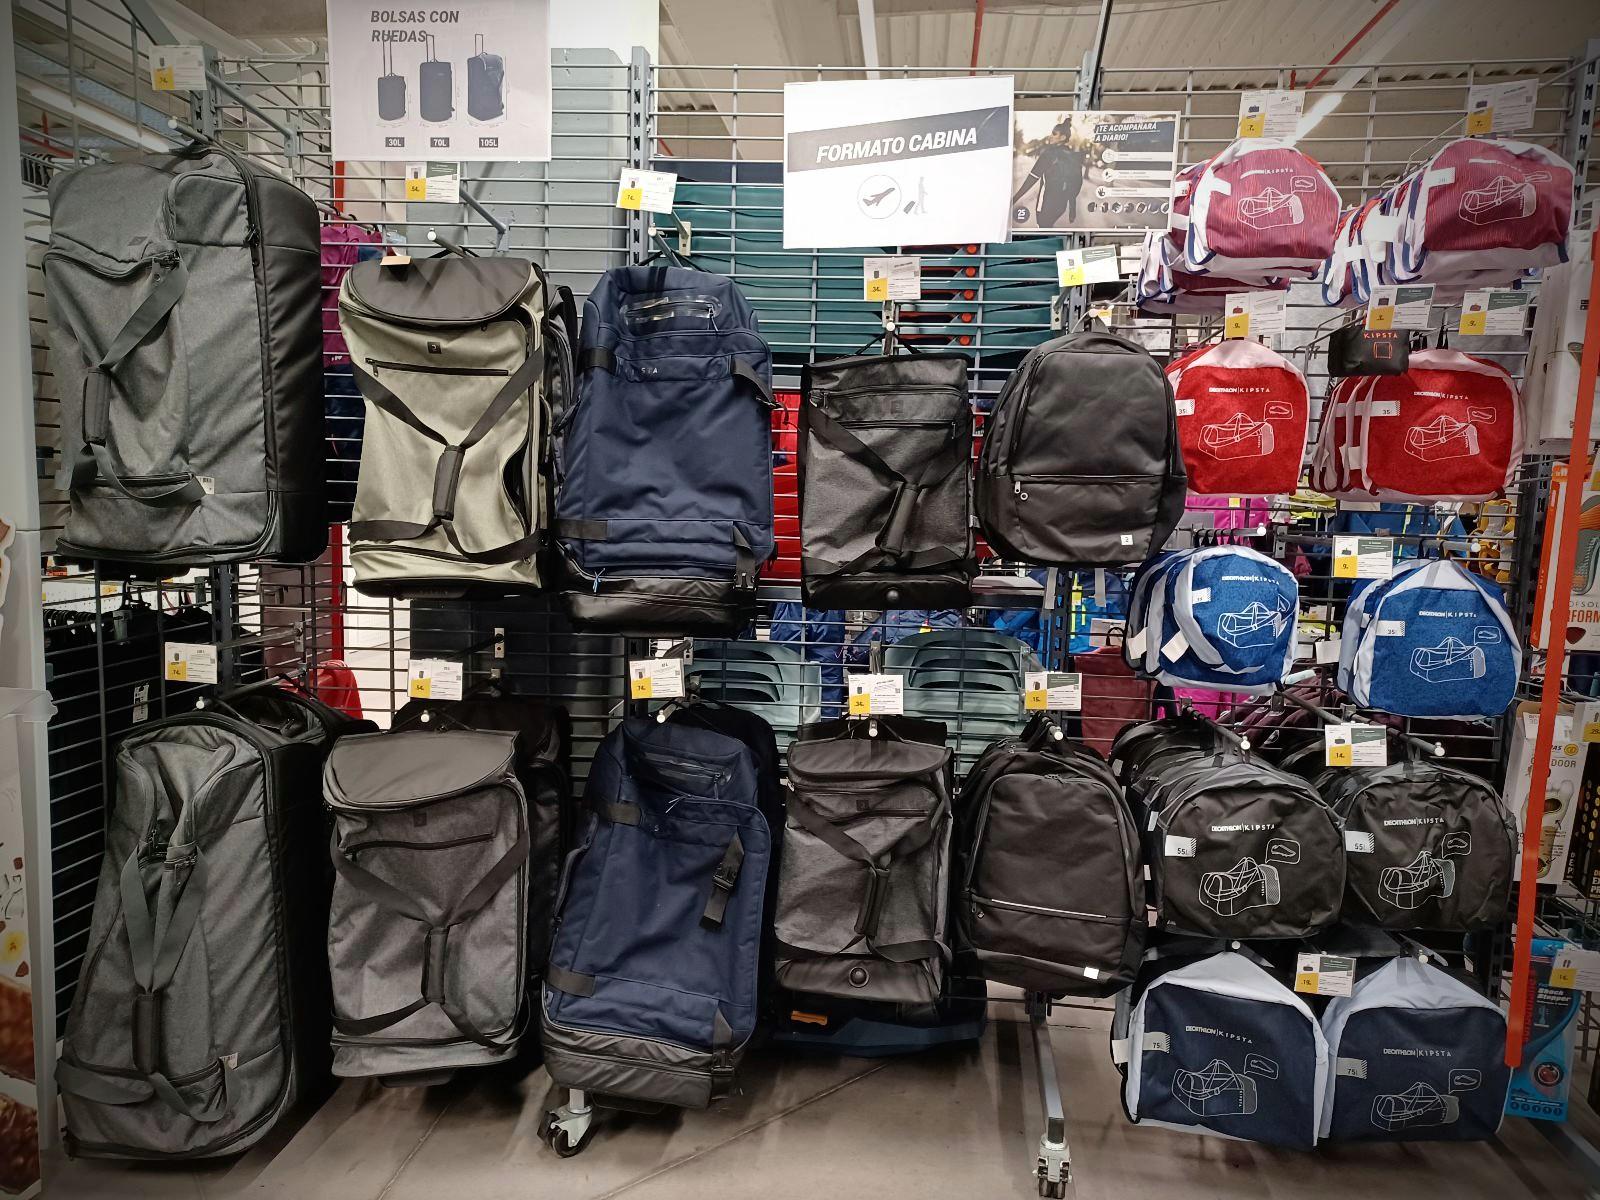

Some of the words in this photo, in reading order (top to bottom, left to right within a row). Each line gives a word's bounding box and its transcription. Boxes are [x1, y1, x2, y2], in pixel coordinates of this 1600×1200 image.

[371, 10, 426, 23] BOLSAS
[429, 10, 460, 23] CON
[372, 30, 427, 43] RUEDAS
[1102, 133, 1129, 141] DIARIO!
[388, 138, 403, 147] 30L
[433, 138, 447, 147] 70L
[480, 138, 499, 147] 105L
[815, 136, 905, 164] FORMATO
[908, 127, 978, 152] CABINA
[1244, 823, 1275, 831] KIPSTA
[1383, 819, 1417, 827] DECATHLON
[1185, 1025, 1217, 1035] DECATHLON
[1218, 1031, 1253, 1044] KIPSTA
[1383, 1047, 1416, 1056] DECATHLON
[1418, 1049, 1452, 1057] KIPSTA
